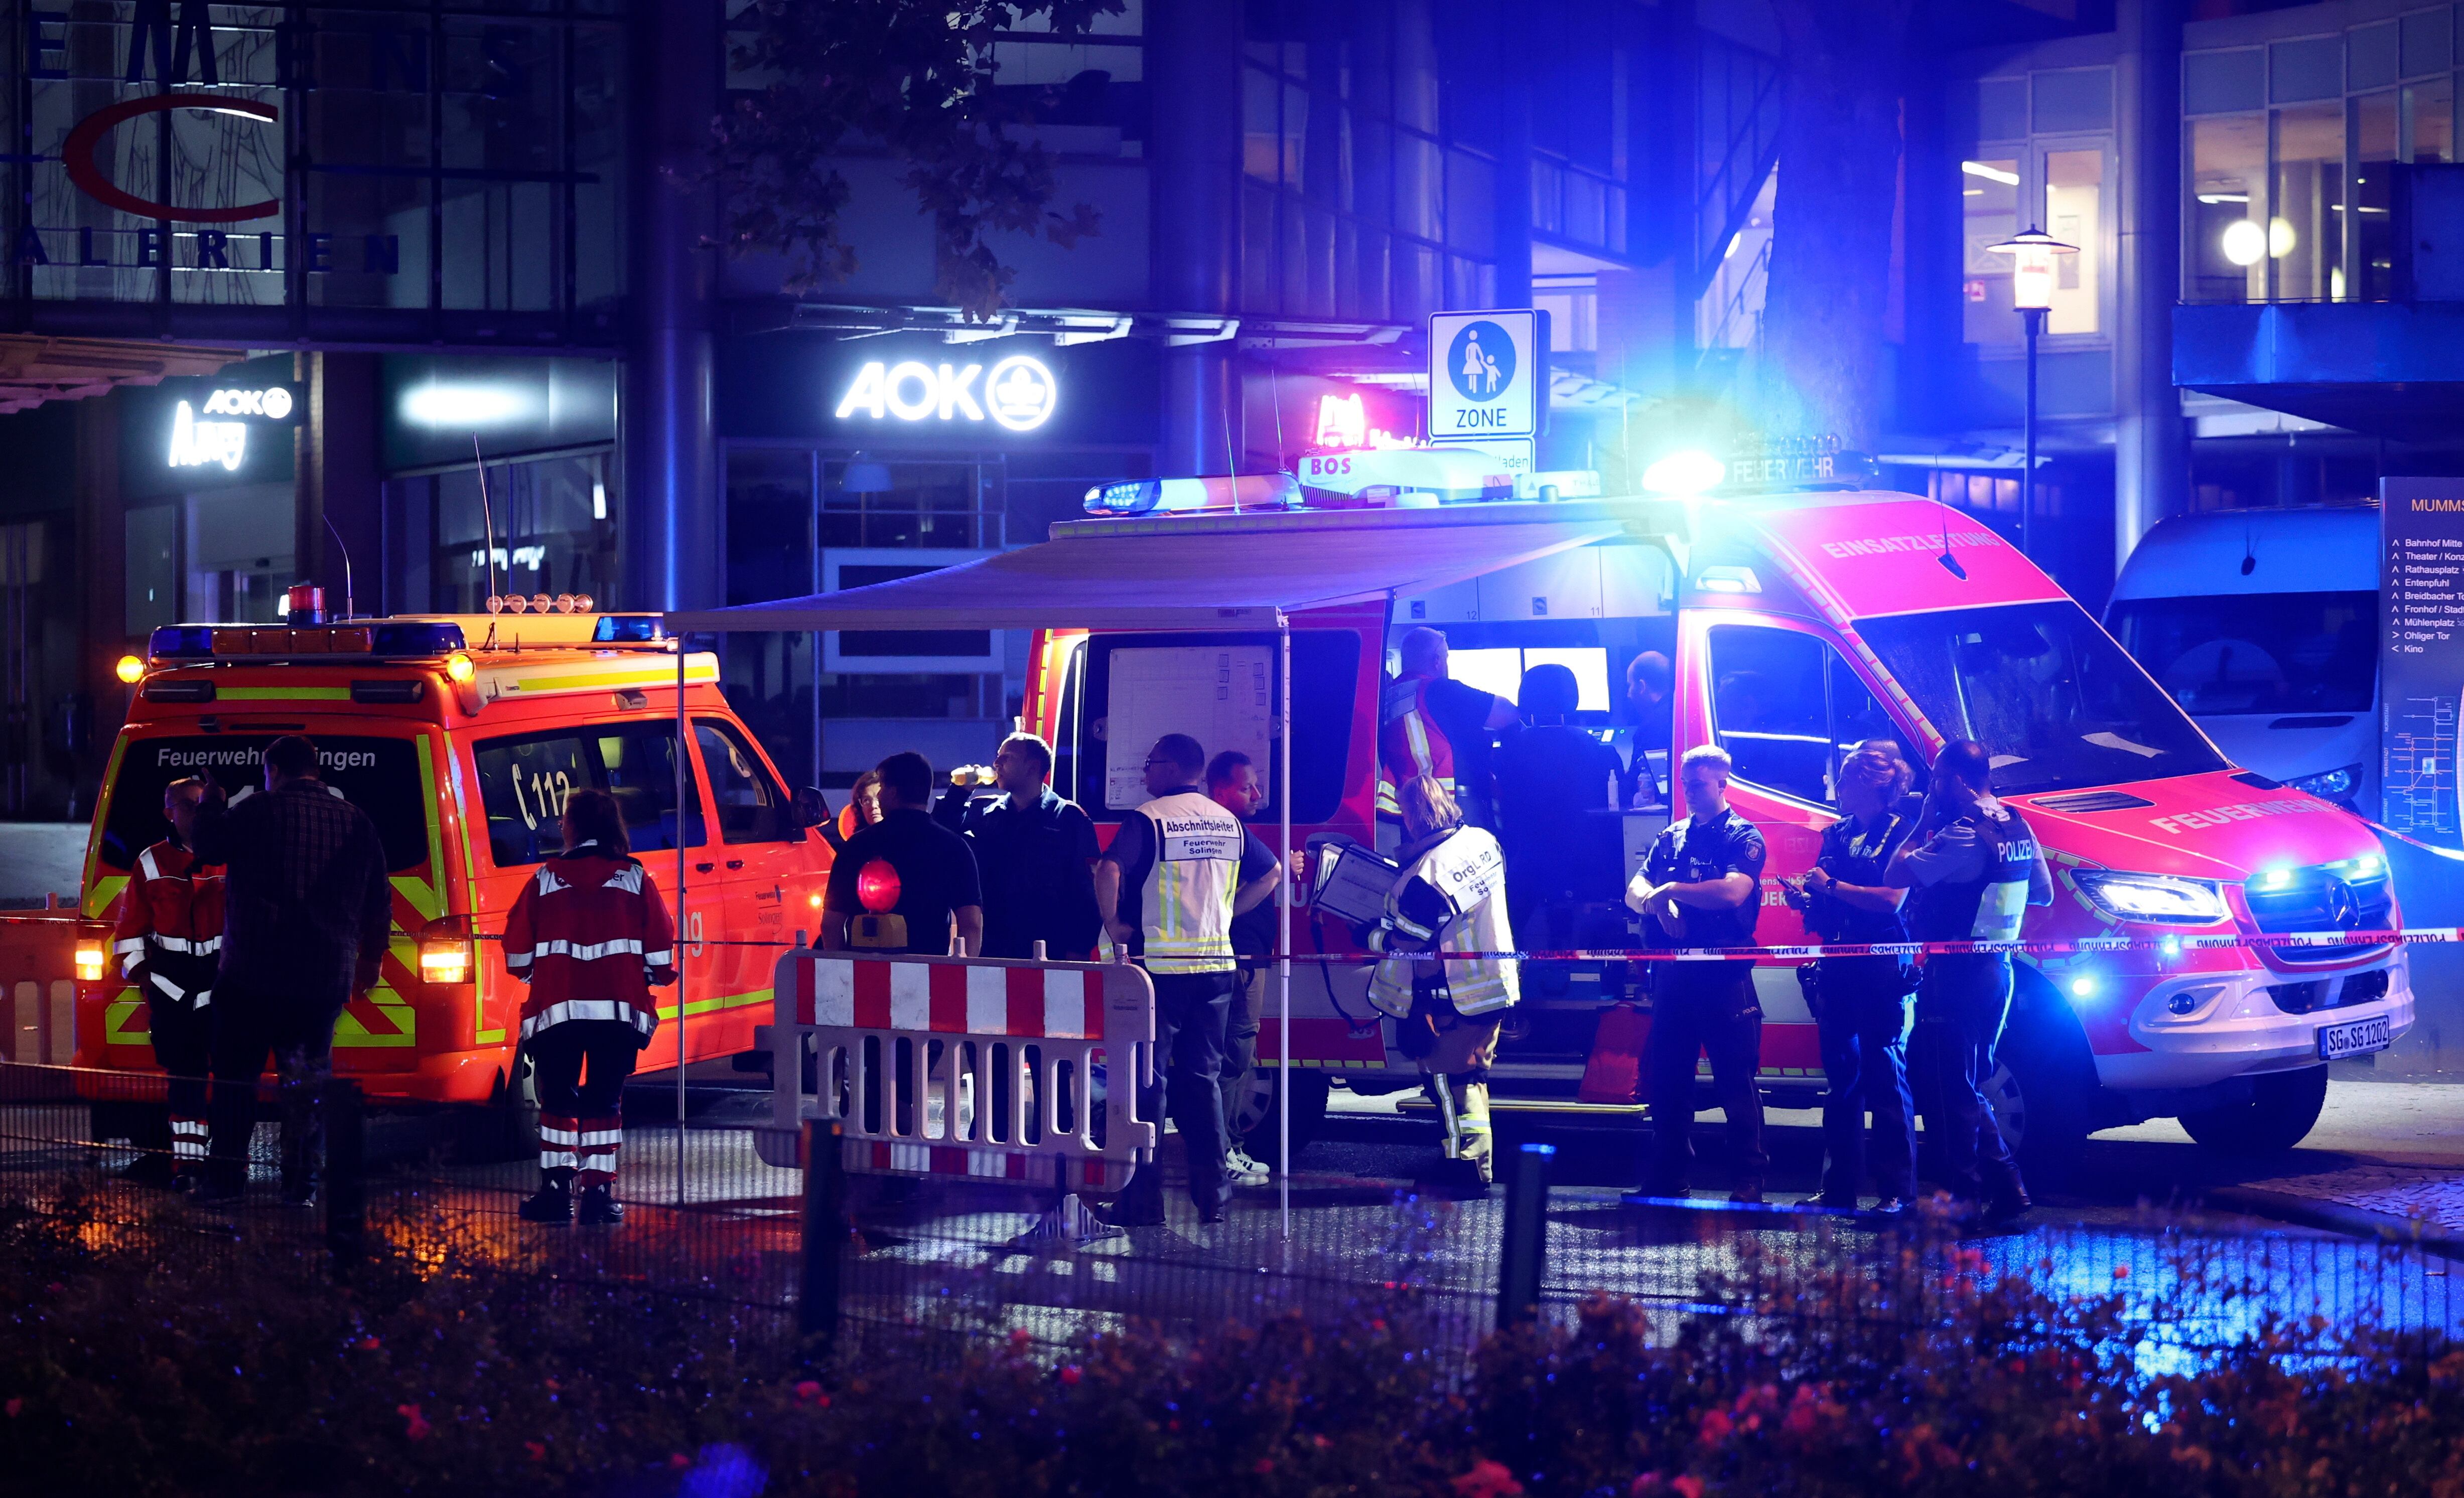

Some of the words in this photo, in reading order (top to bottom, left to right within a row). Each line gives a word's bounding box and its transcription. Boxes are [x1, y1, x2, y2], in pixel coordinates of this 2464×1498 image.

[835, 361, 985, 420] AOK
[203, 389, 264, 415] AOK
[1456, 408, 1507, 427] ZONE
[1311, 458, 1351, 475] BOS
[1733, 457, 1834, 483] FEUERWEHR
[1820, 532, 2001, 559] EINSATZLEITUNG
[2405, 539, 2441, 547] Bahnhof
[2442, 539, 2462, 547] Mitte
[2405, 552, 2438, 560] Theater
[2405, 565, 2459, 575] Rathausplatz
[2405, 579, 2449, 588] Entenpfuhl
[2405, 592, 2455, 601] Breidbacher
[1591, 607, 1600, 616] 11
[2404, 605, 2437, 613] Fronhof
[1466, 611, 1477, 620] 12
[2404, 618, 2455, 628] Mühlenplatz
[2404, 632, 2435, 642] Ohliger
[2436, 632, 2450, 640] Tor
[2404, 645, 2423, 653] Kino
[2148, 799, 2335, 834] FEUERWEHR
[1166, 820, 1234, 833] Abschnittsleiter
[1997, 839, 2032, 863] POLIZEI
[2329, 1029, 2343, 1052] SG
[2351, 1026, 2364, 1048] SG
[2365, 1021, 2388, 1045] 1202
